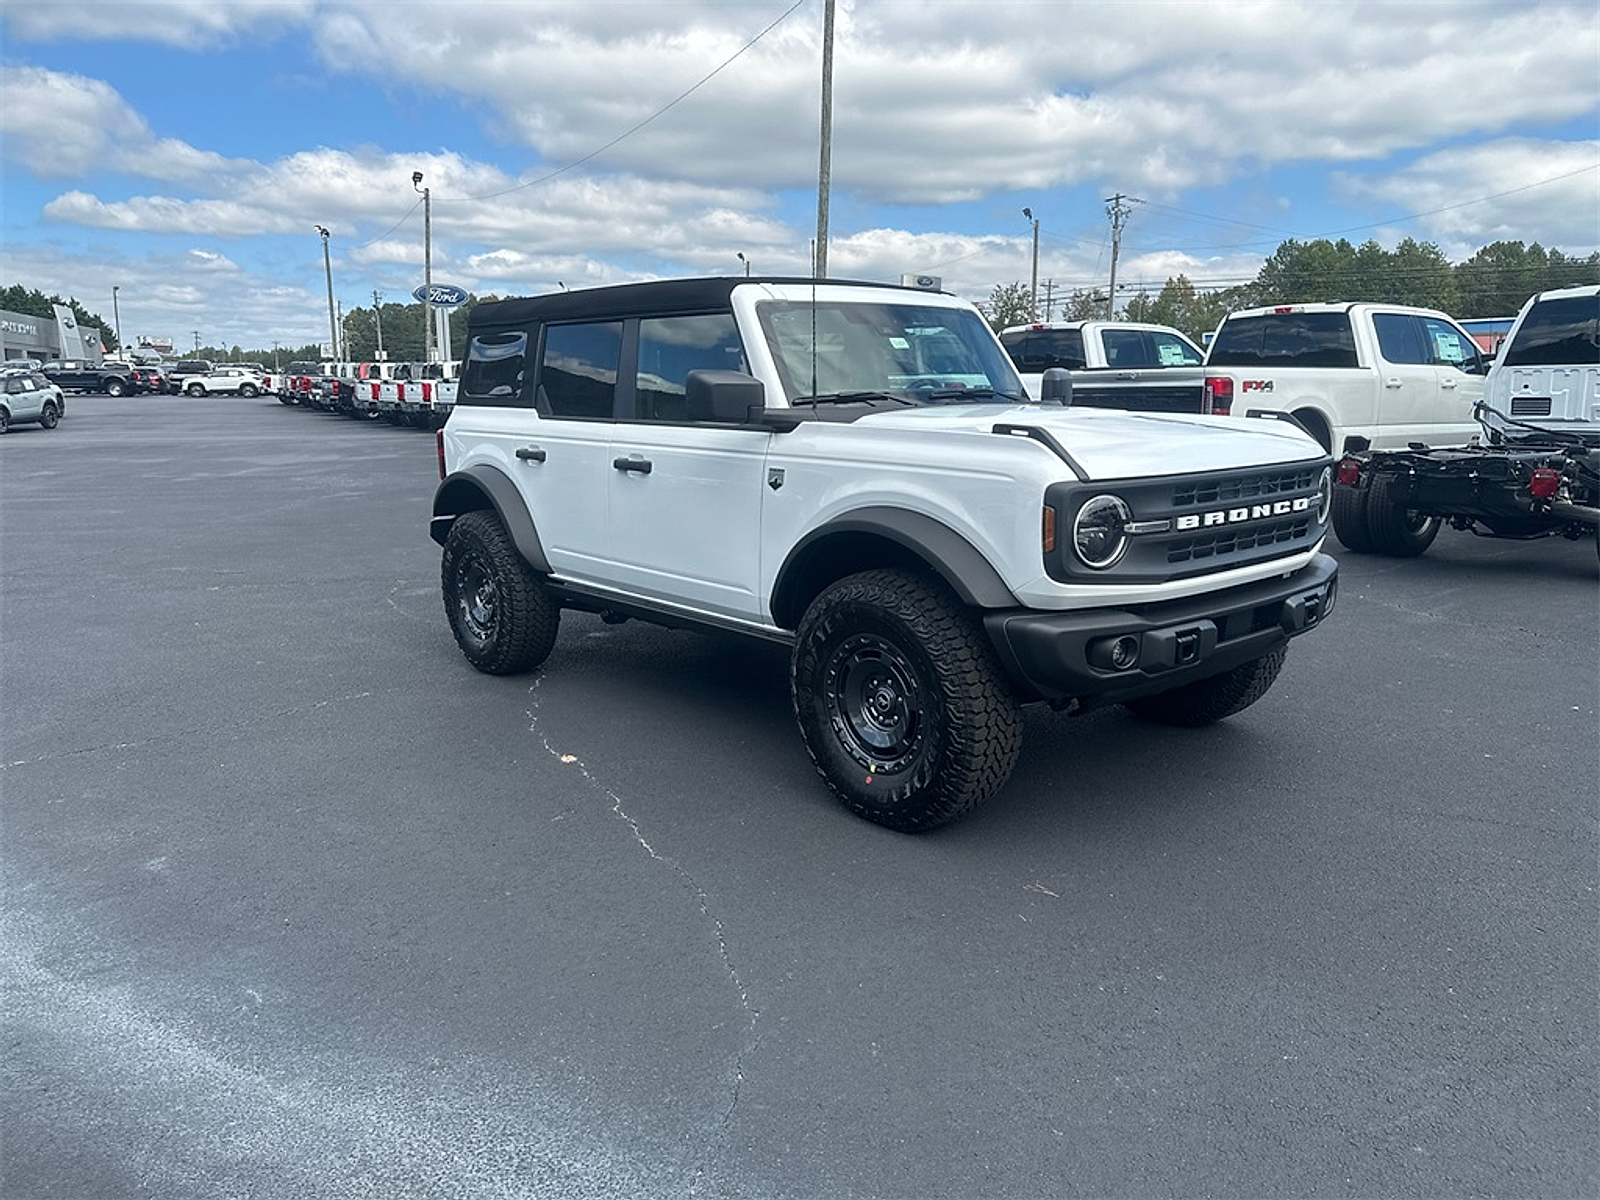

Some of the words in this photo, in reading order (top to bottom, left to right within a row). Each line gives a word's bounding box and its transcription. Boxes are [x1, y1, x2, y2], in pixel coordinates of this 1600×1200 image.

[429, 287, 460, 303] Ford
[1242, 380, 1274, 393] FX4
[1176, 498, 1309, 530] BRONCO
